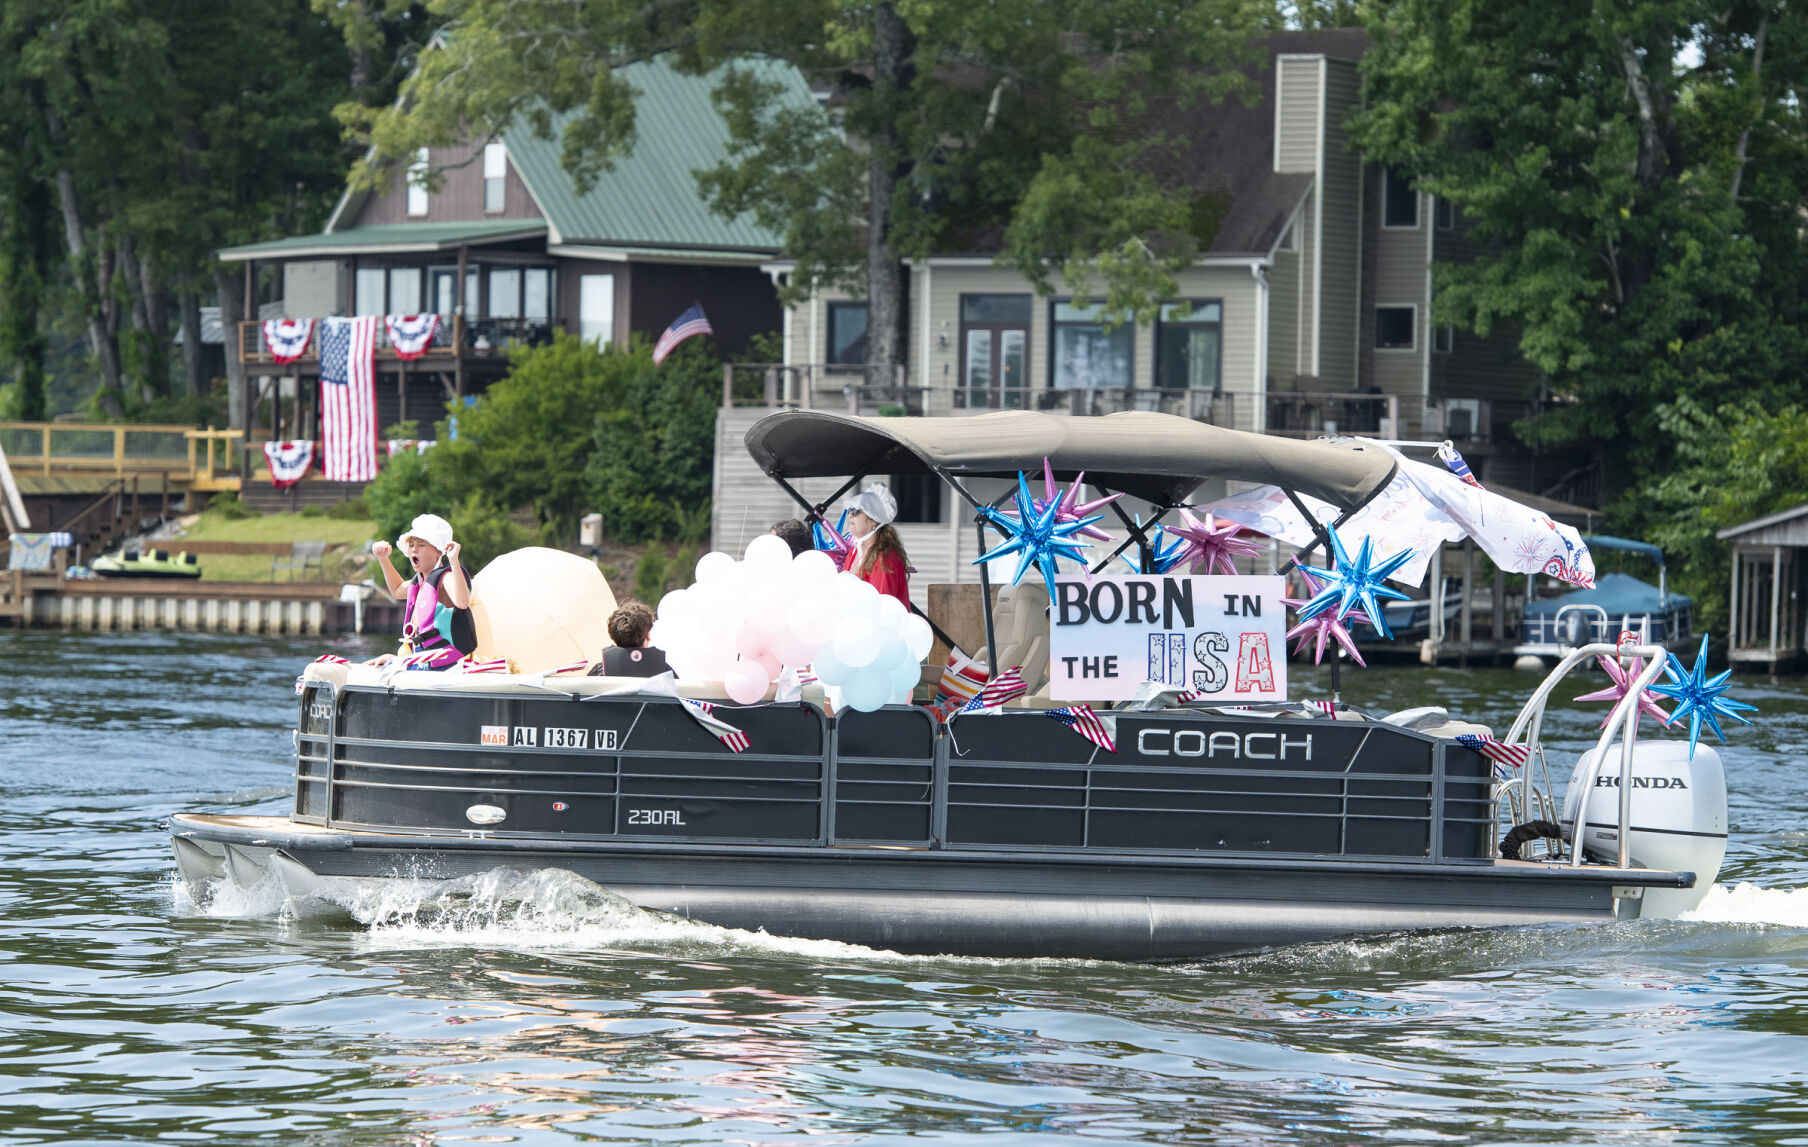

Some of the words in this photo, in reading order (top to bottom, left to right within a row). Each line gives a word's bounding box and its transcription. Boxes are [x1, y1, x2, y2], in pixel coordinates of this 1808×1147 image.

[1056, 577, 1194, 629] BORN
[1223, 594, 1261, 617] IN
[1061, 655, 1118, 678] THE
[1147, 632, 1276, 693] USA
[482, 733, 506, 745] MAR
[515, 728, 535, 746] AL
[548, 729, 586, 747] 1367
[597, 731, 616, 748] VB
[1137, 728, 1312, 760] COACH
[628, 809, 687, 826] 230RL
